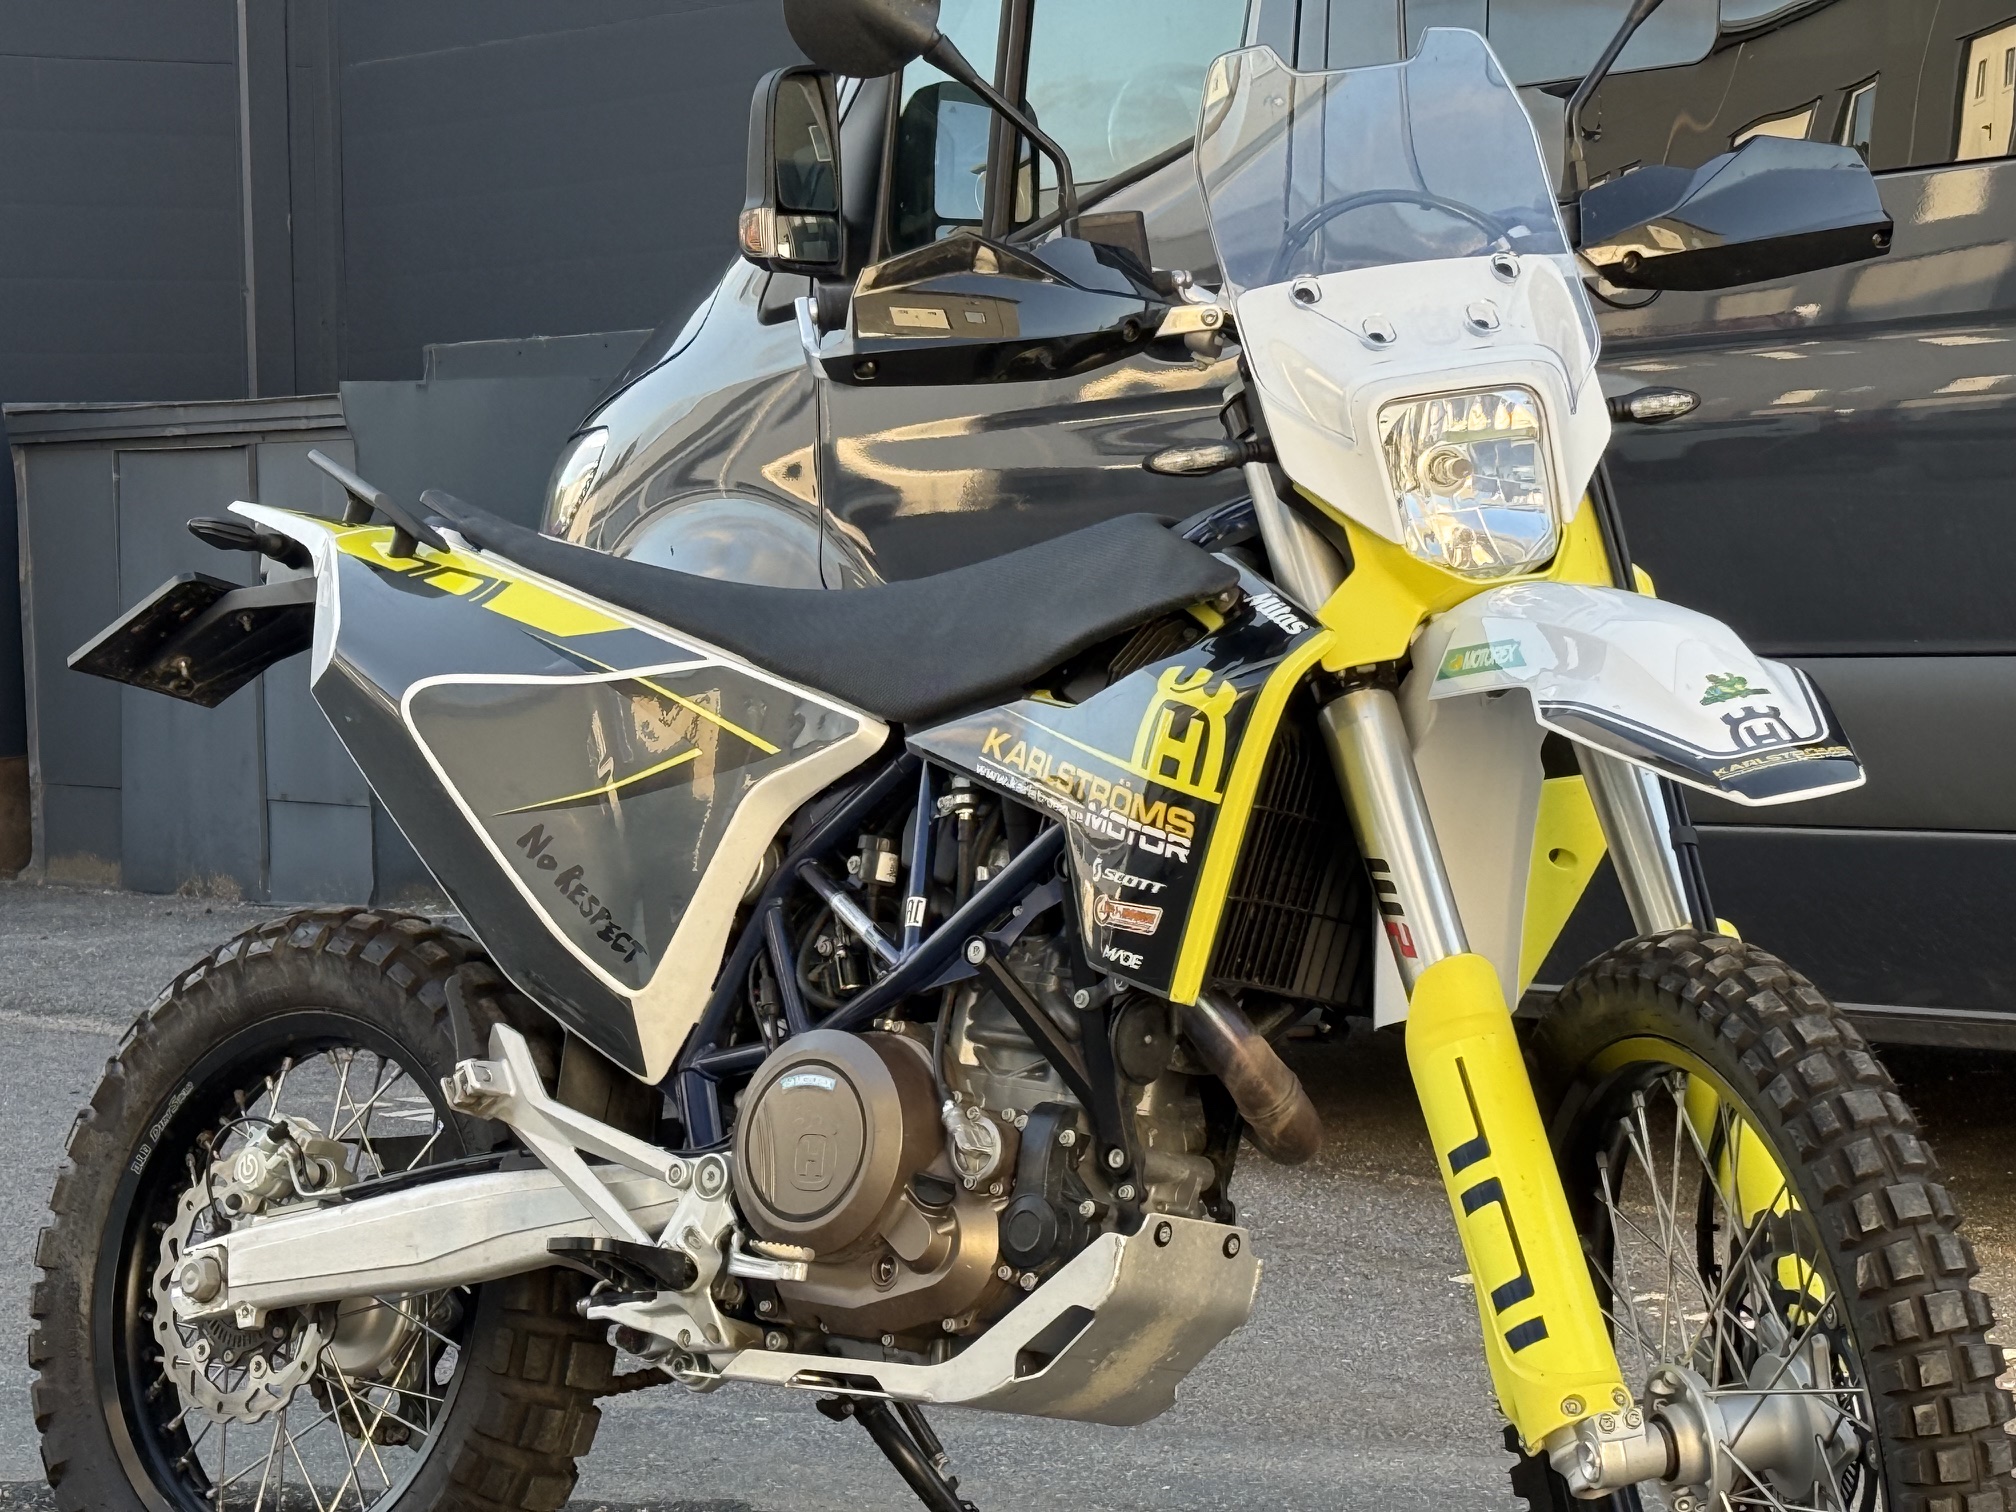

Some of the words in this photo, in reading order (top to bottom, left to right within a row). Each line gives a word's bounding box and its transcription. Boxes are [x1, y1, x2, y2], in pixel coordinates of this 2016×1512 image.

[1462, 643, 1519, 670] MOTOREX
[981, 728, 1196, 839] KARLSTRÖMS
[1085, 801, 1193, 864] MOTOR
[1102, 867, 1168, 894] SCOTT
[554, 864, 648, 964] RESPECT
